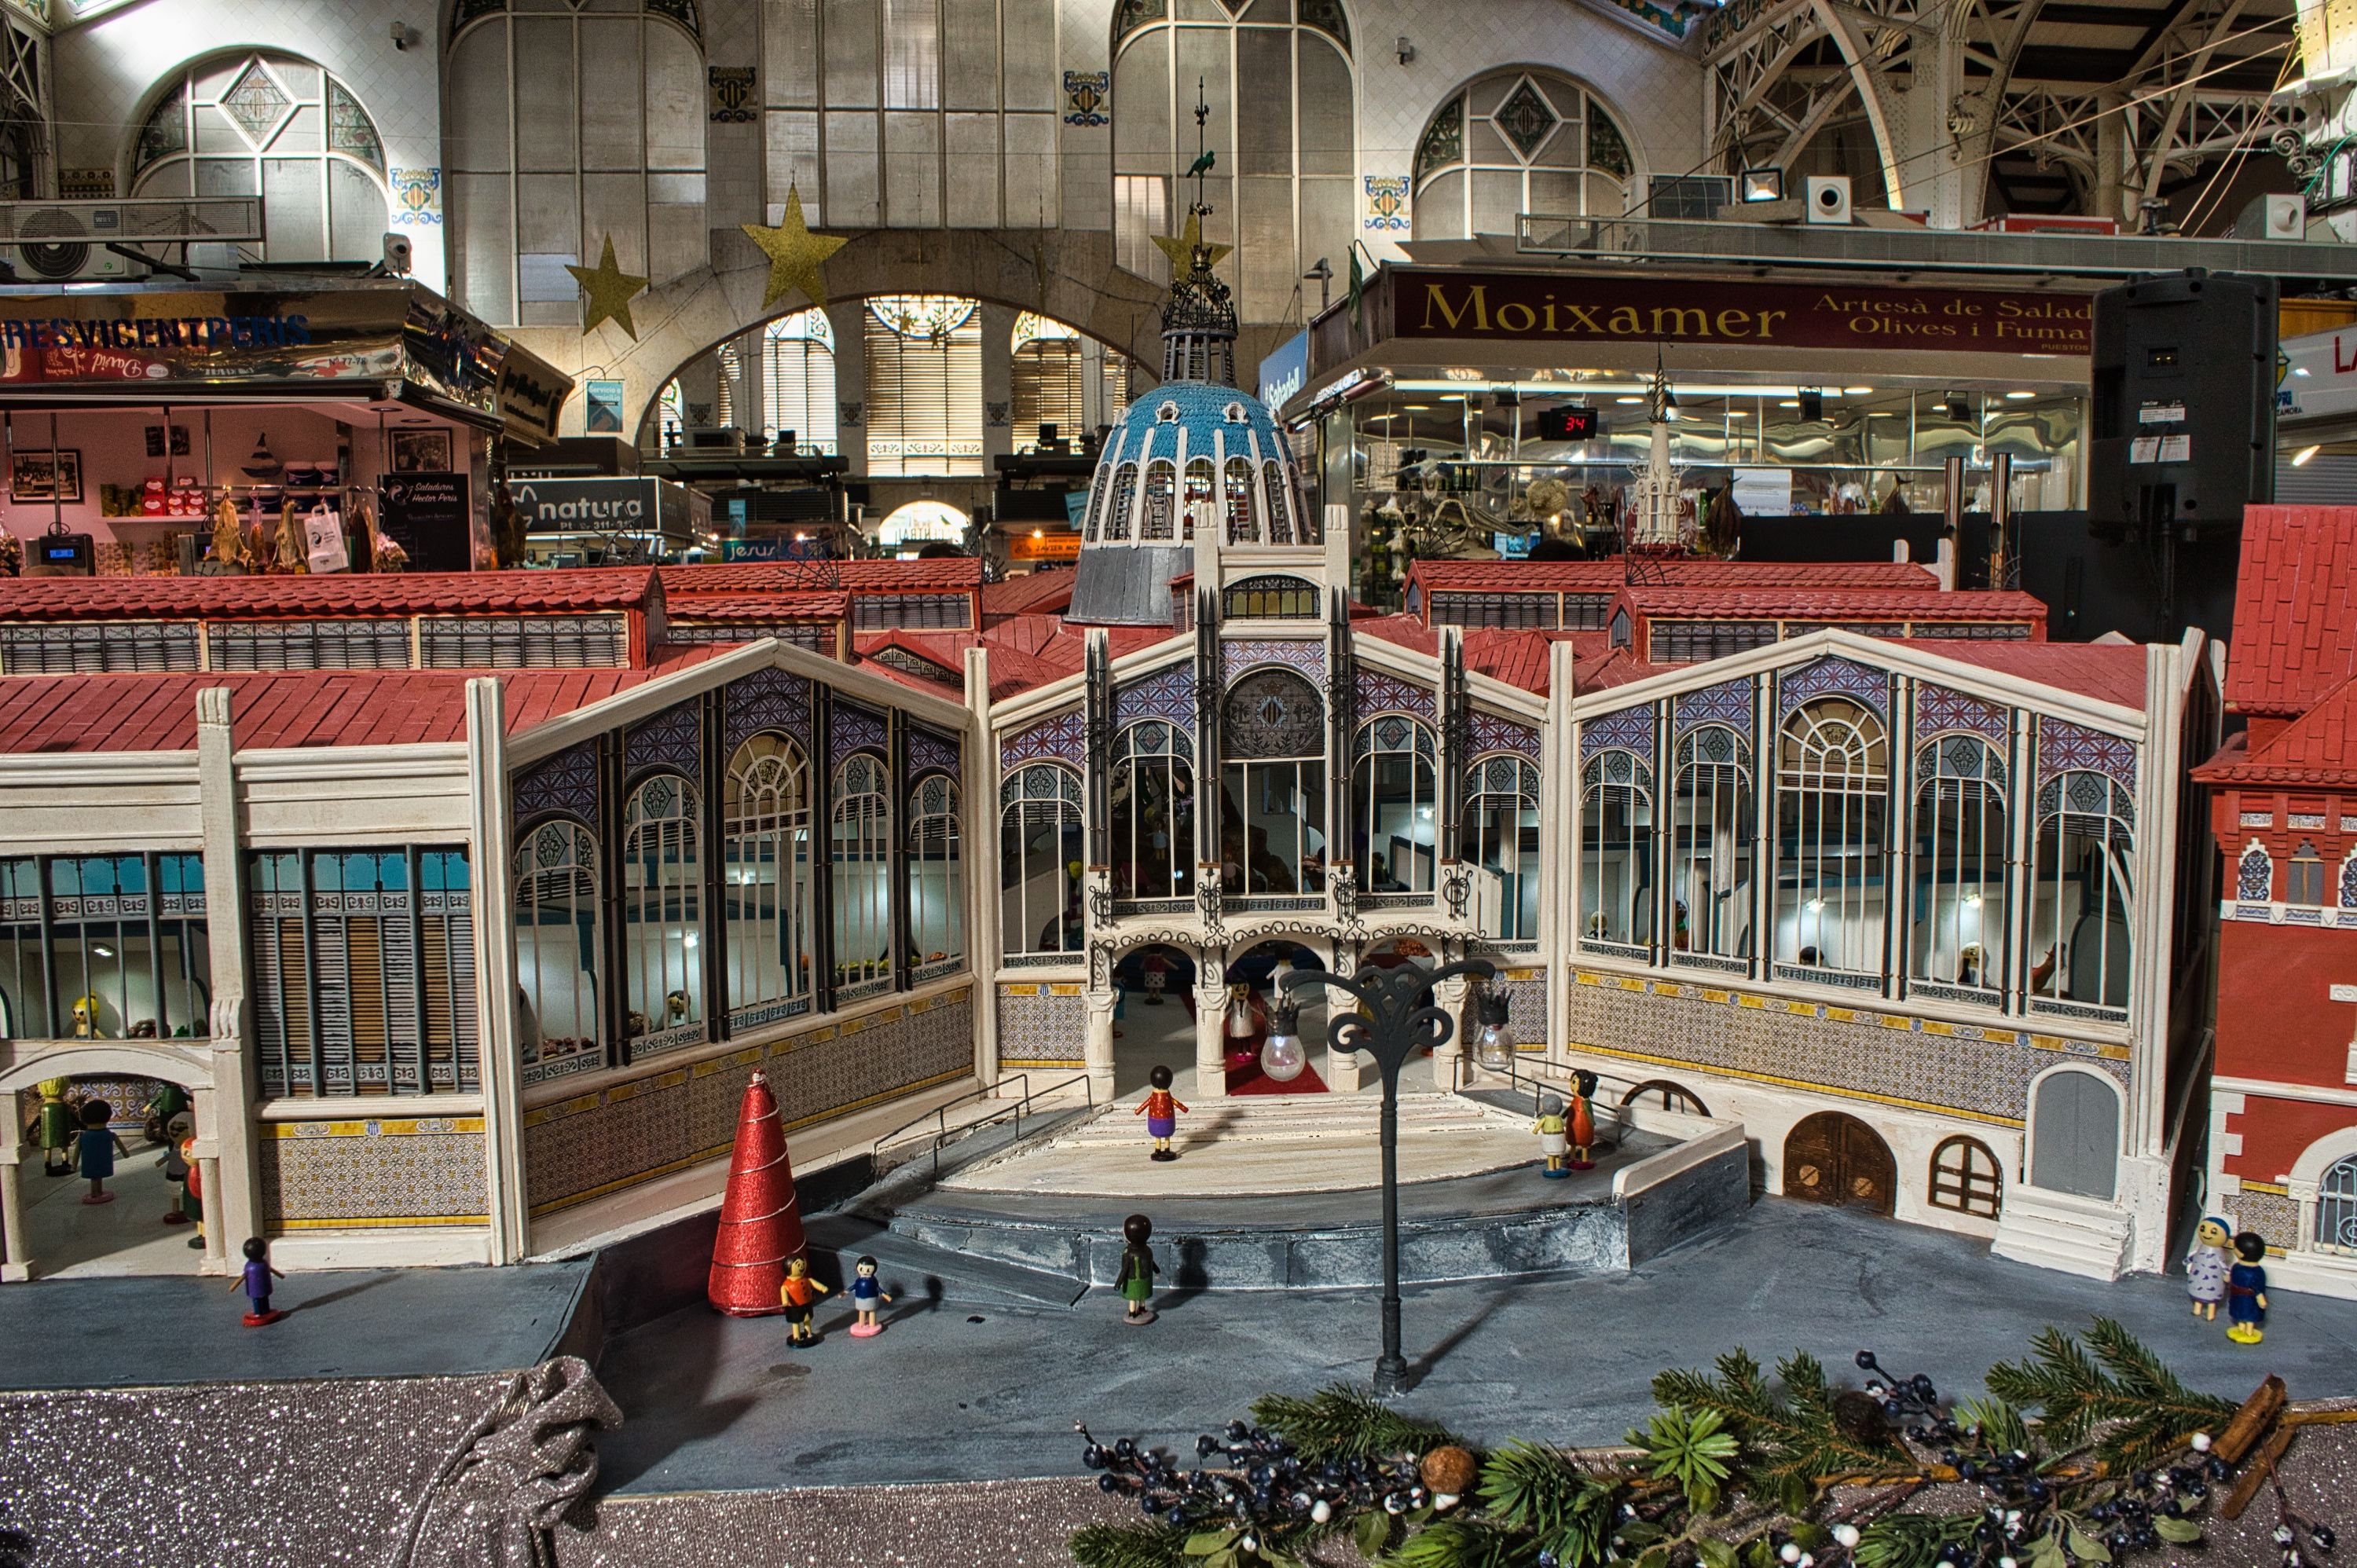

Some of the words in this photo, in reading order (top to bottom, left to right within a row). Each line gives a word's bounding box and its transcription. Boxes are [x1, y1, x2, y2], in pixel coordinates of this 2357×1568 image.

[1420, 284, 1786, 338] Moixamer
[1813, 294, 1928, 314] Artesà
[1943, 299, 1982, 315] de
[1849, 317, 1957, 336] Olives
[1971, 323, 1979, 336] i
[1996, 321, 2093, 340] Fuma
[2334, 336, 2357, 373] L
[1565, 416, 1585, 431] 34
[539, 497, 642, 520] natura
